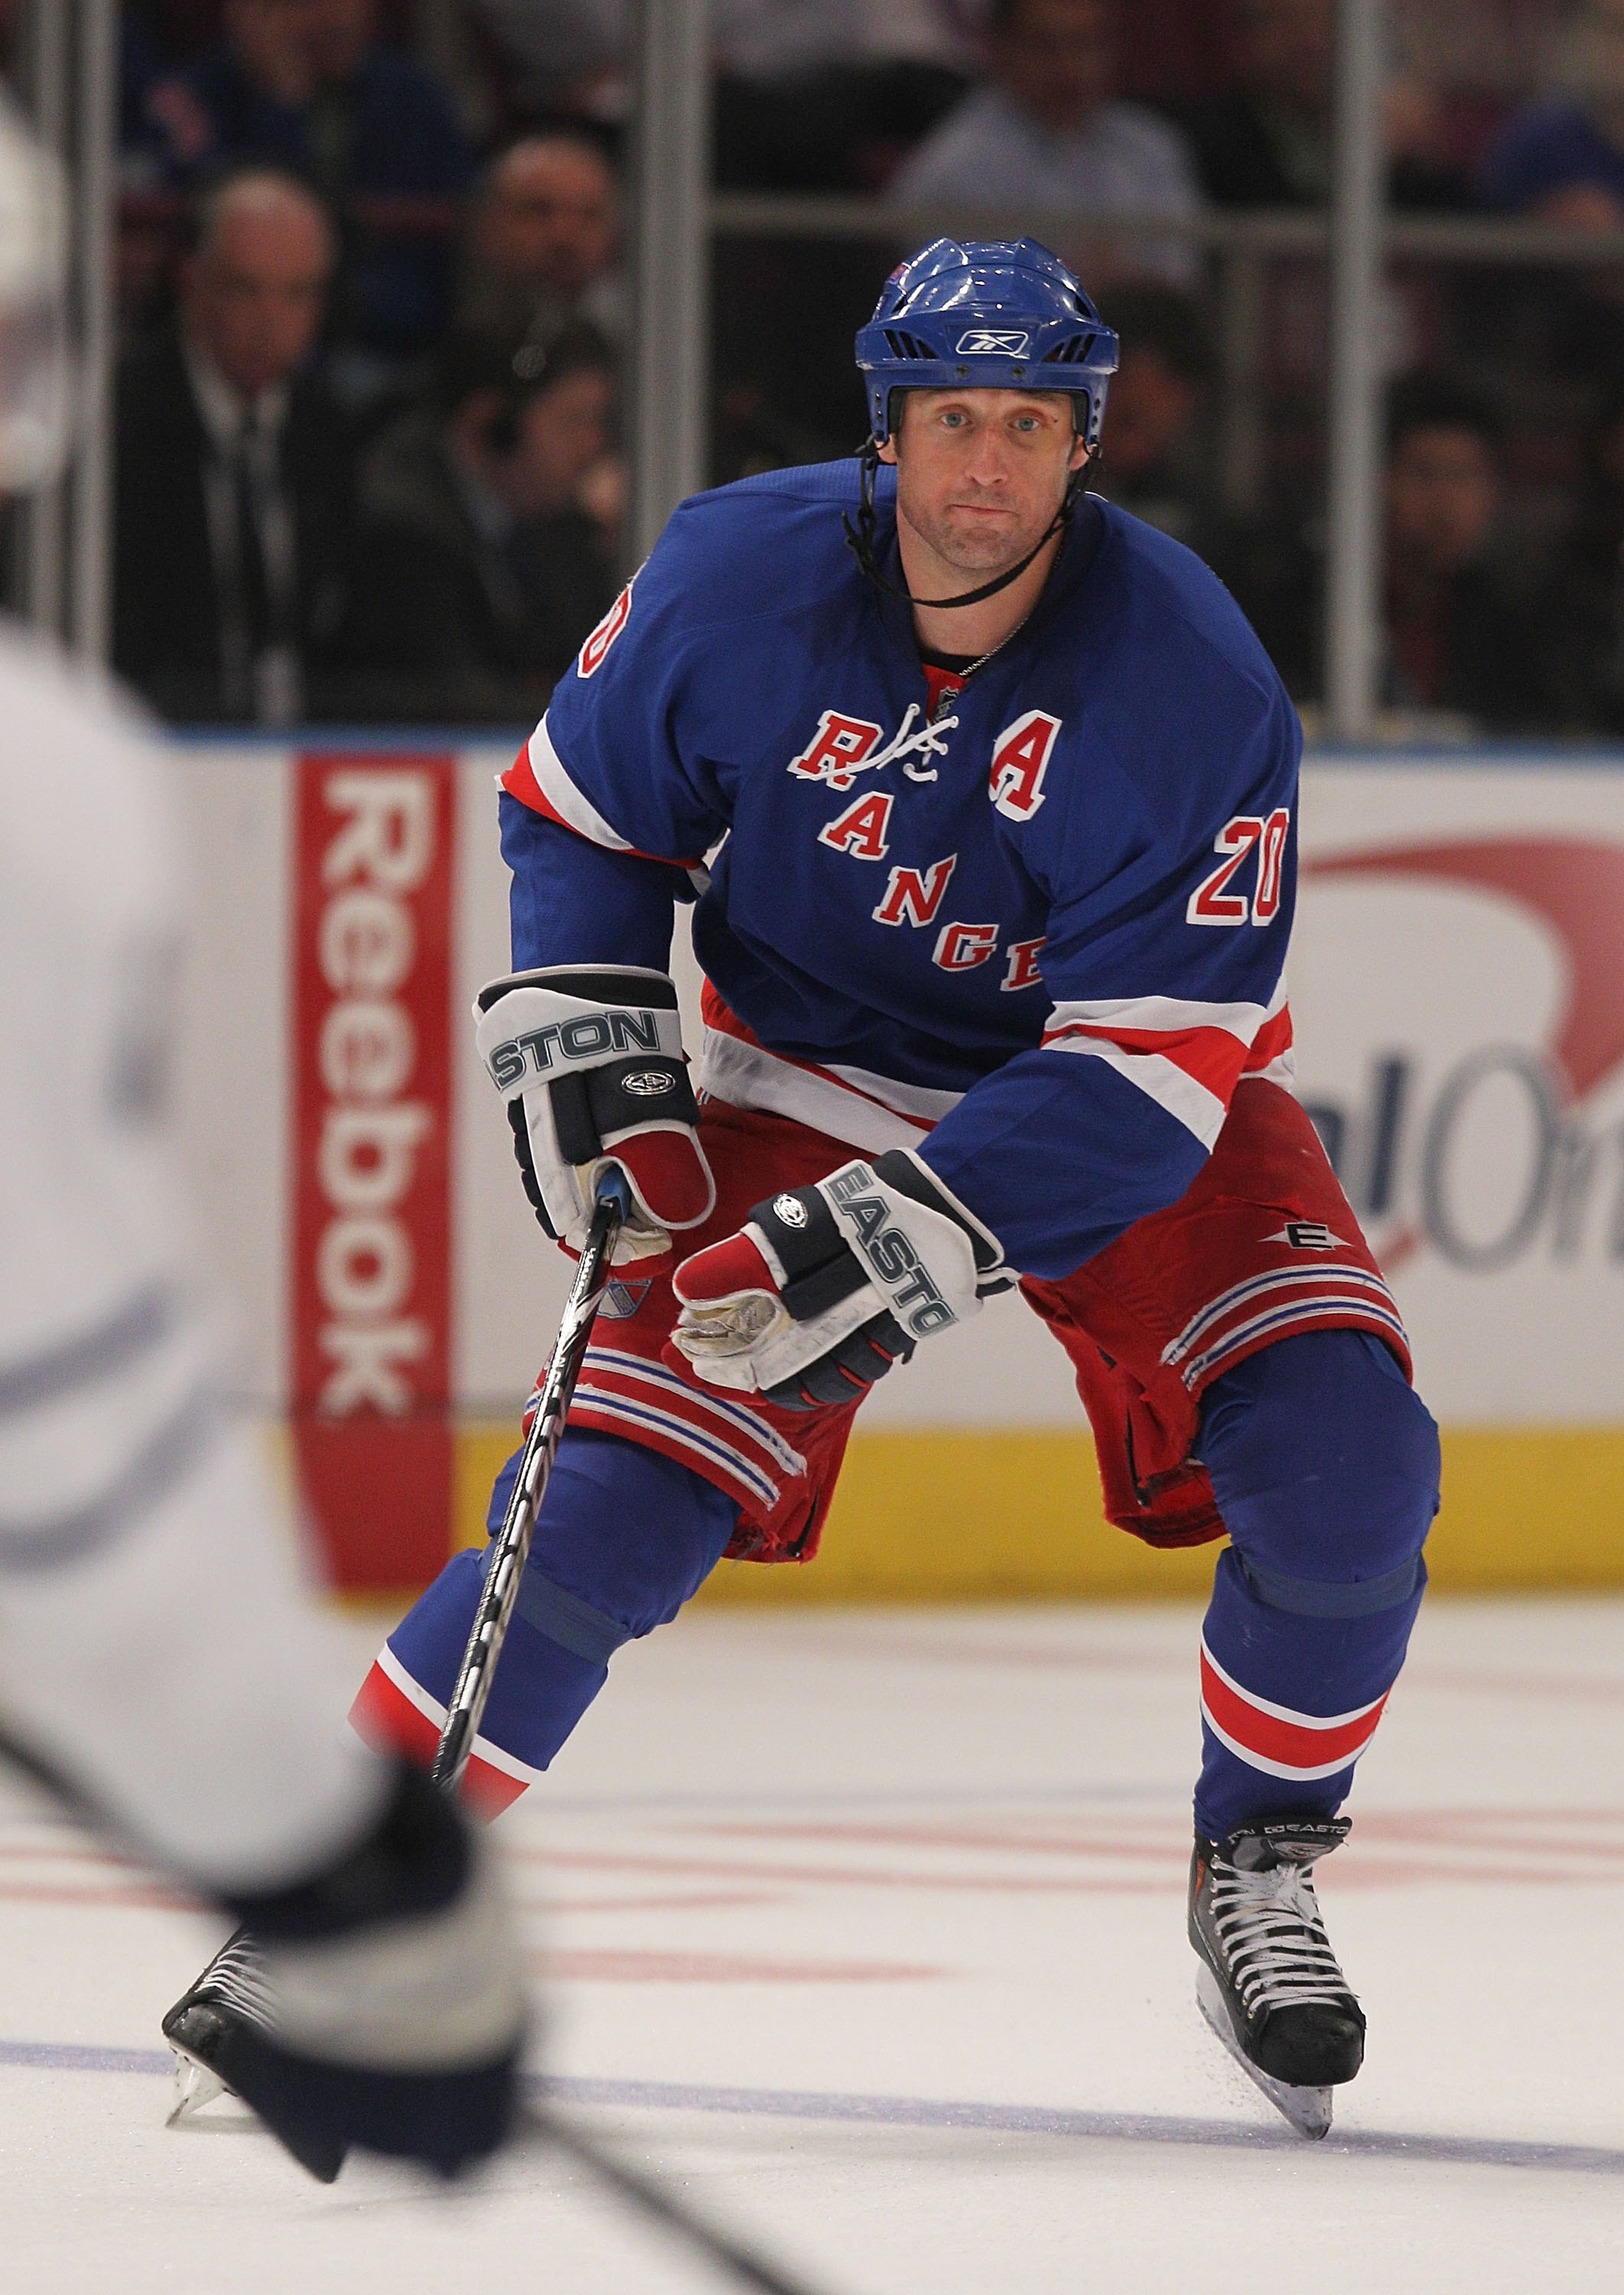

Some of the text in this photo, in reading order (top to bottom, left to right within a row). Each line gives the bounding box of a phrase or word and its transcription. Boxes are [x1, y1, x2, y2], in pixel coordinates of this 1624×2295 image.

[988, 709, 1063, 822] A
[1186, 807, 1290, 926] 20
[315, 768, 434, 1424] Reebok
[483, 1010, 661, 1092] STON
[823, 1164, 959, 1339] EASTO
[1286, 1223, 1333, 1249] E
